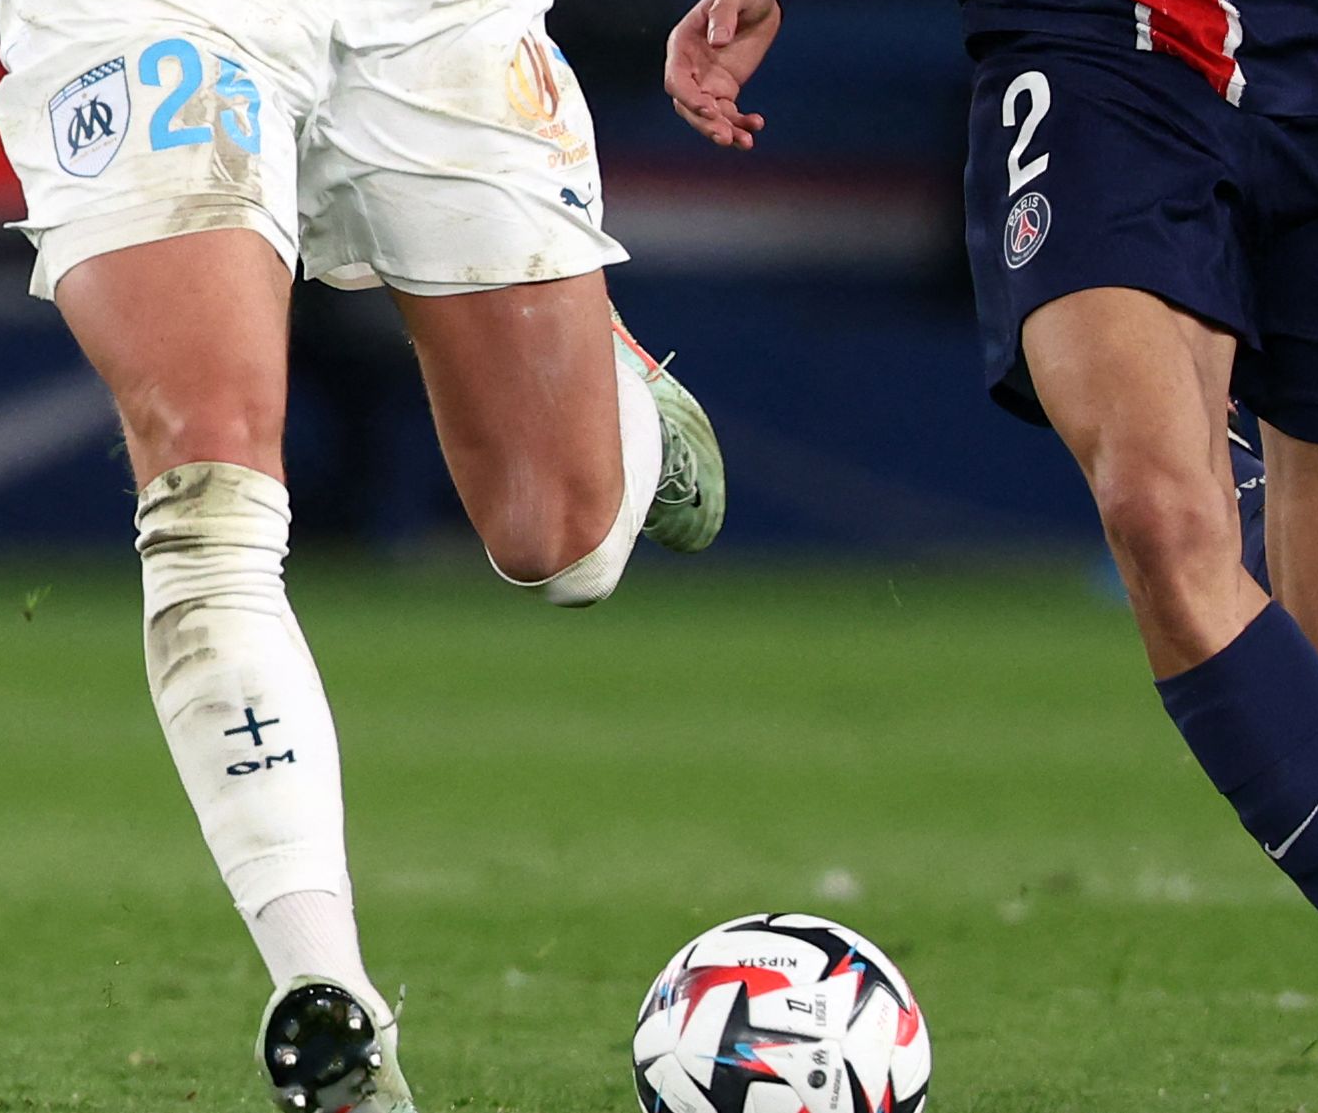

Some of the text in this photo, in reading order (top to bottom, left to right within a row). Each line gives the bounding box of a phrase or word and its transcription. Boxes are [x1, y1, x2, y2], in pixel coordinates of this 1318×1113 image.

[1002, 70, 1051, 197] 2
[1008, 196, 1039, 227] PARIS
[226, 749, 296, 775] OM
[737, 956, 798, 969] KIPSTA
